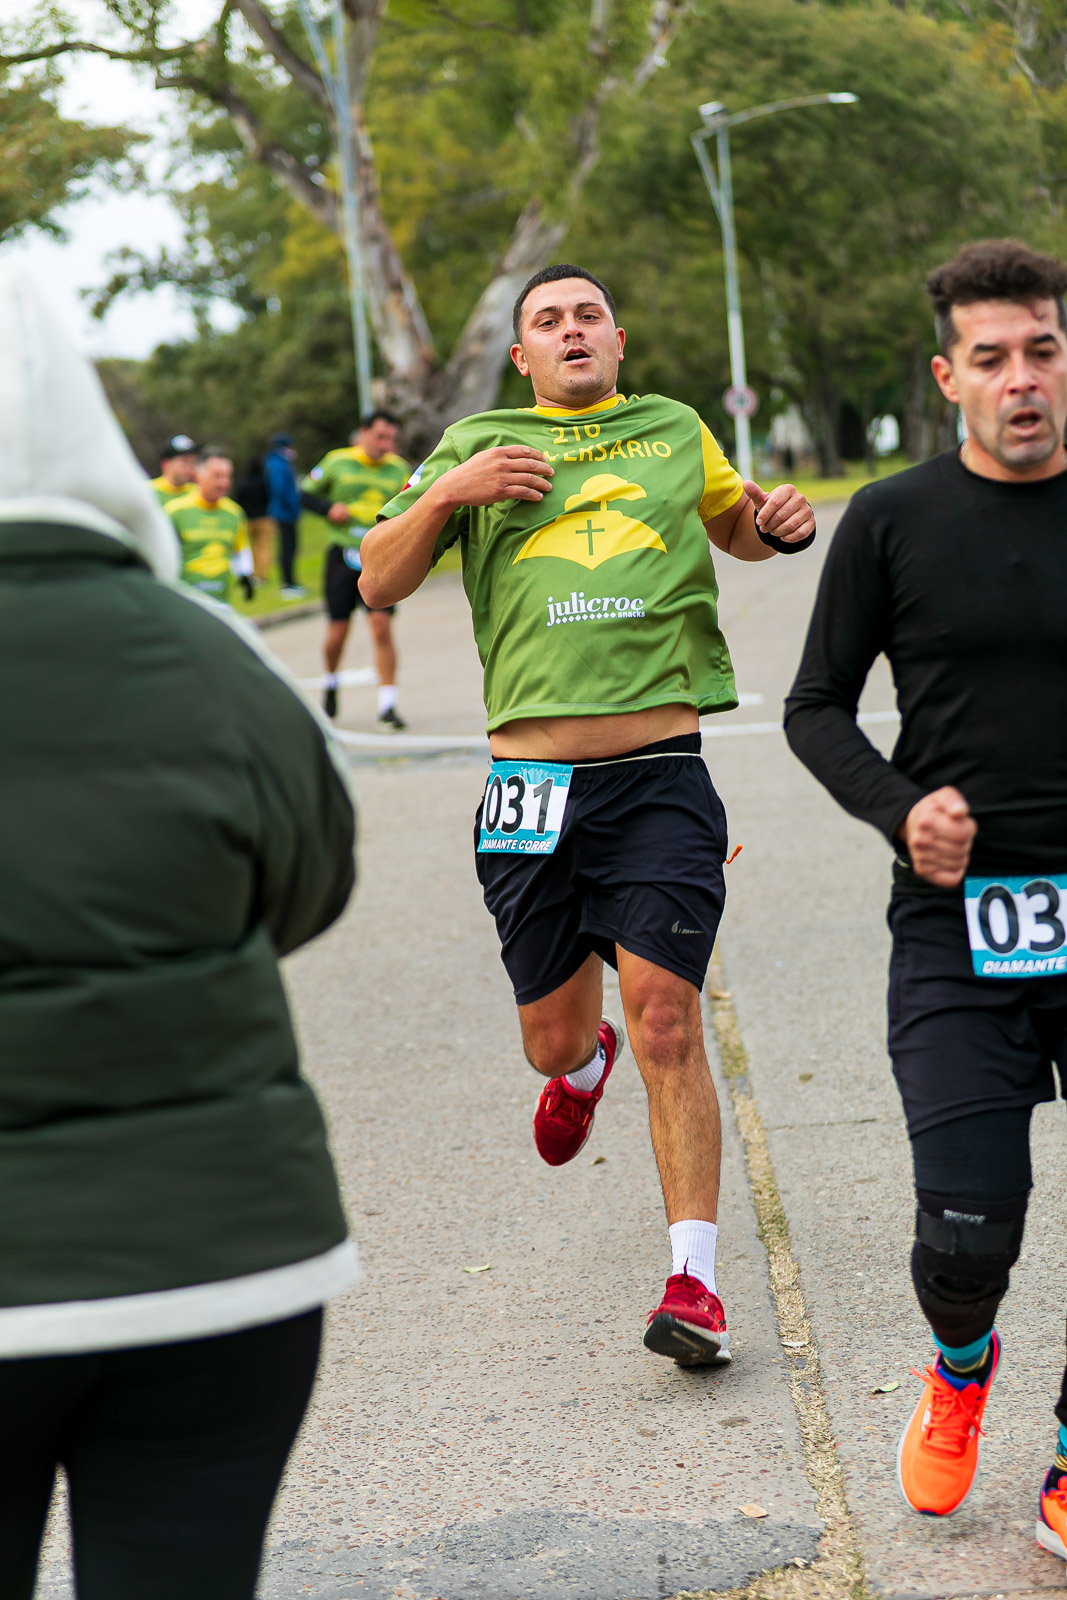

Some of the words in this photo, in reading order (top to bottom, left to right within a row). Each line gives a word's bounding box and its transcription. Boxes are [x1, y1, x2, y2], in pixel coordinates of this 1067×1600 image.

[546, 592, 644, 627] julicroc
[617, 610, 646, 618] snacks
[485, 774, 554, 835] 031
[481, 838, 518, 850] DIAMANTE
[518, 839, 552, 851] CORRE
[978, 878, 1066, 957] 03
[982, 956, 1067, 974] DIAMANTE
